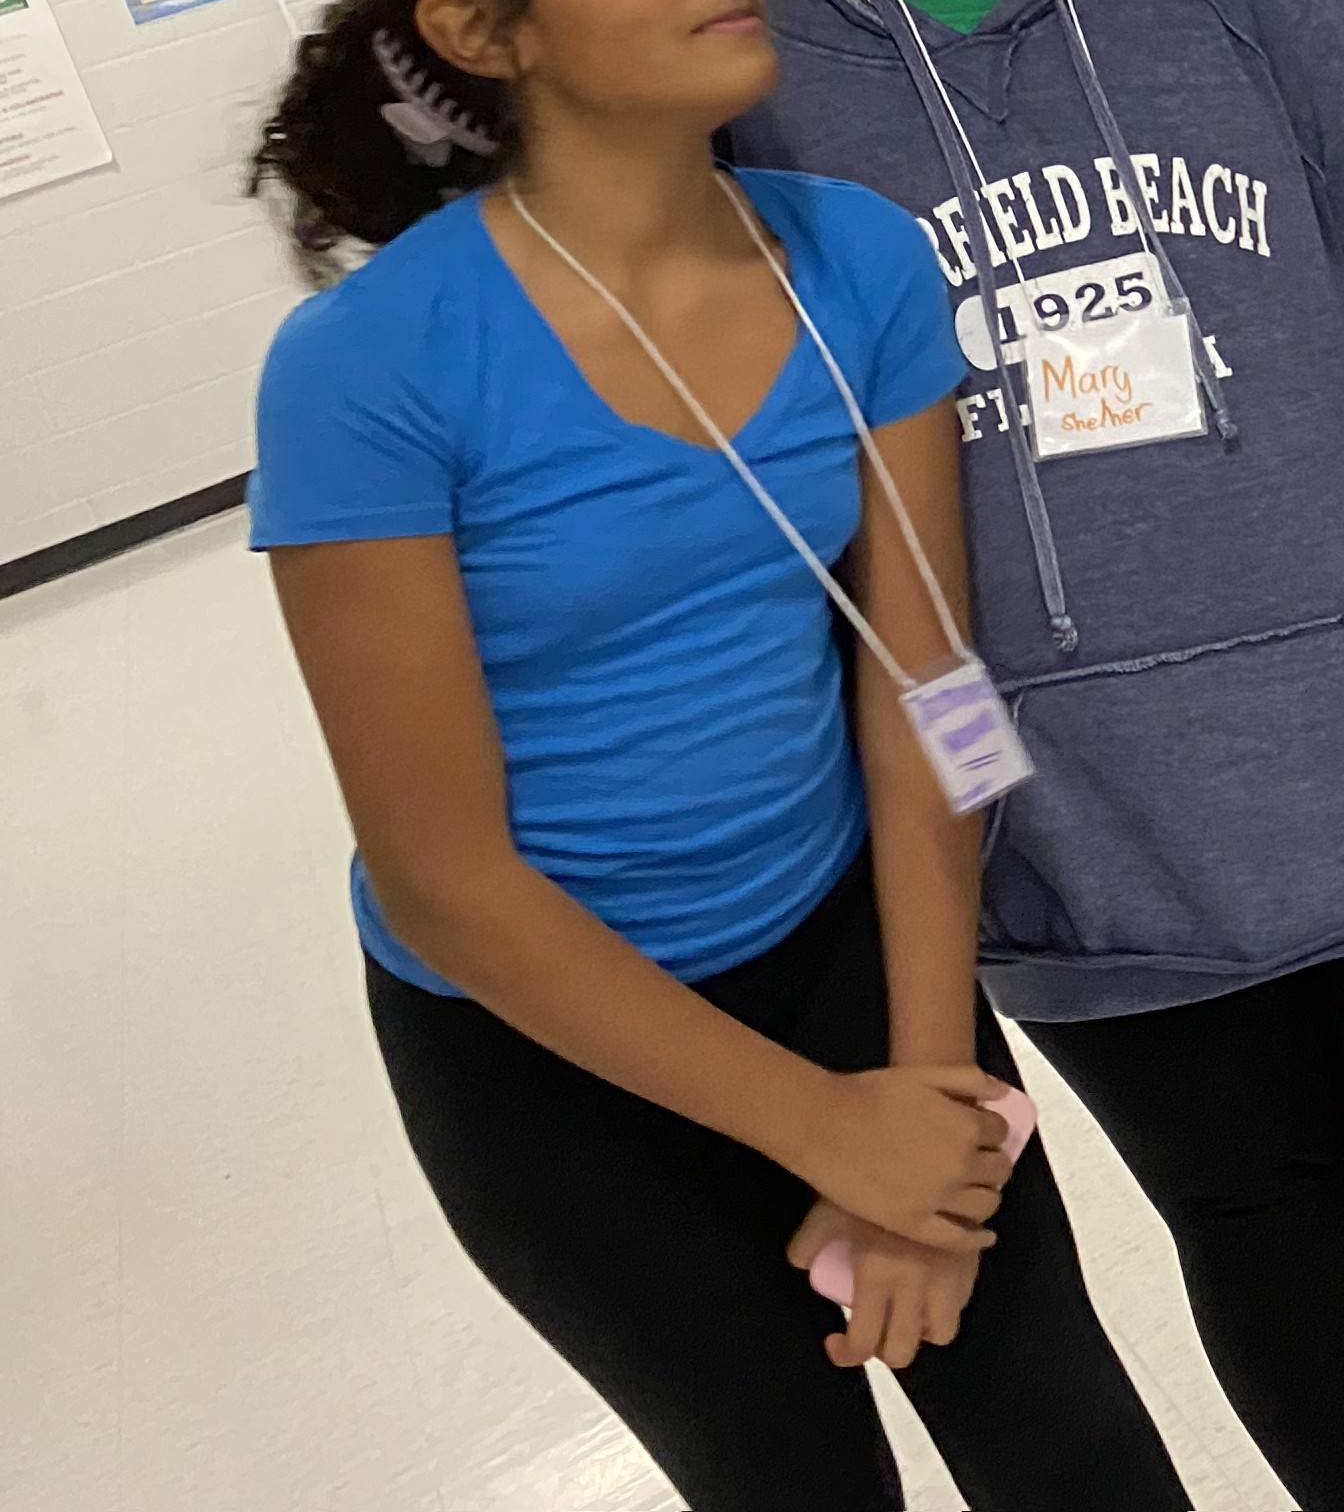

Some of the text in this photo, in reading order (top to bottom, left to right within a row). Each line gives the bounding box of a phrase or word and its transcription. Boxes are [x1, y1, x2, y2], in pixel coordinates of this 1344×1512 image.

[1094, 153, 1271, 257] BEACH
[996, 271, 1153, 345] 1925
[1042, 355, 1134, 404] Mary
